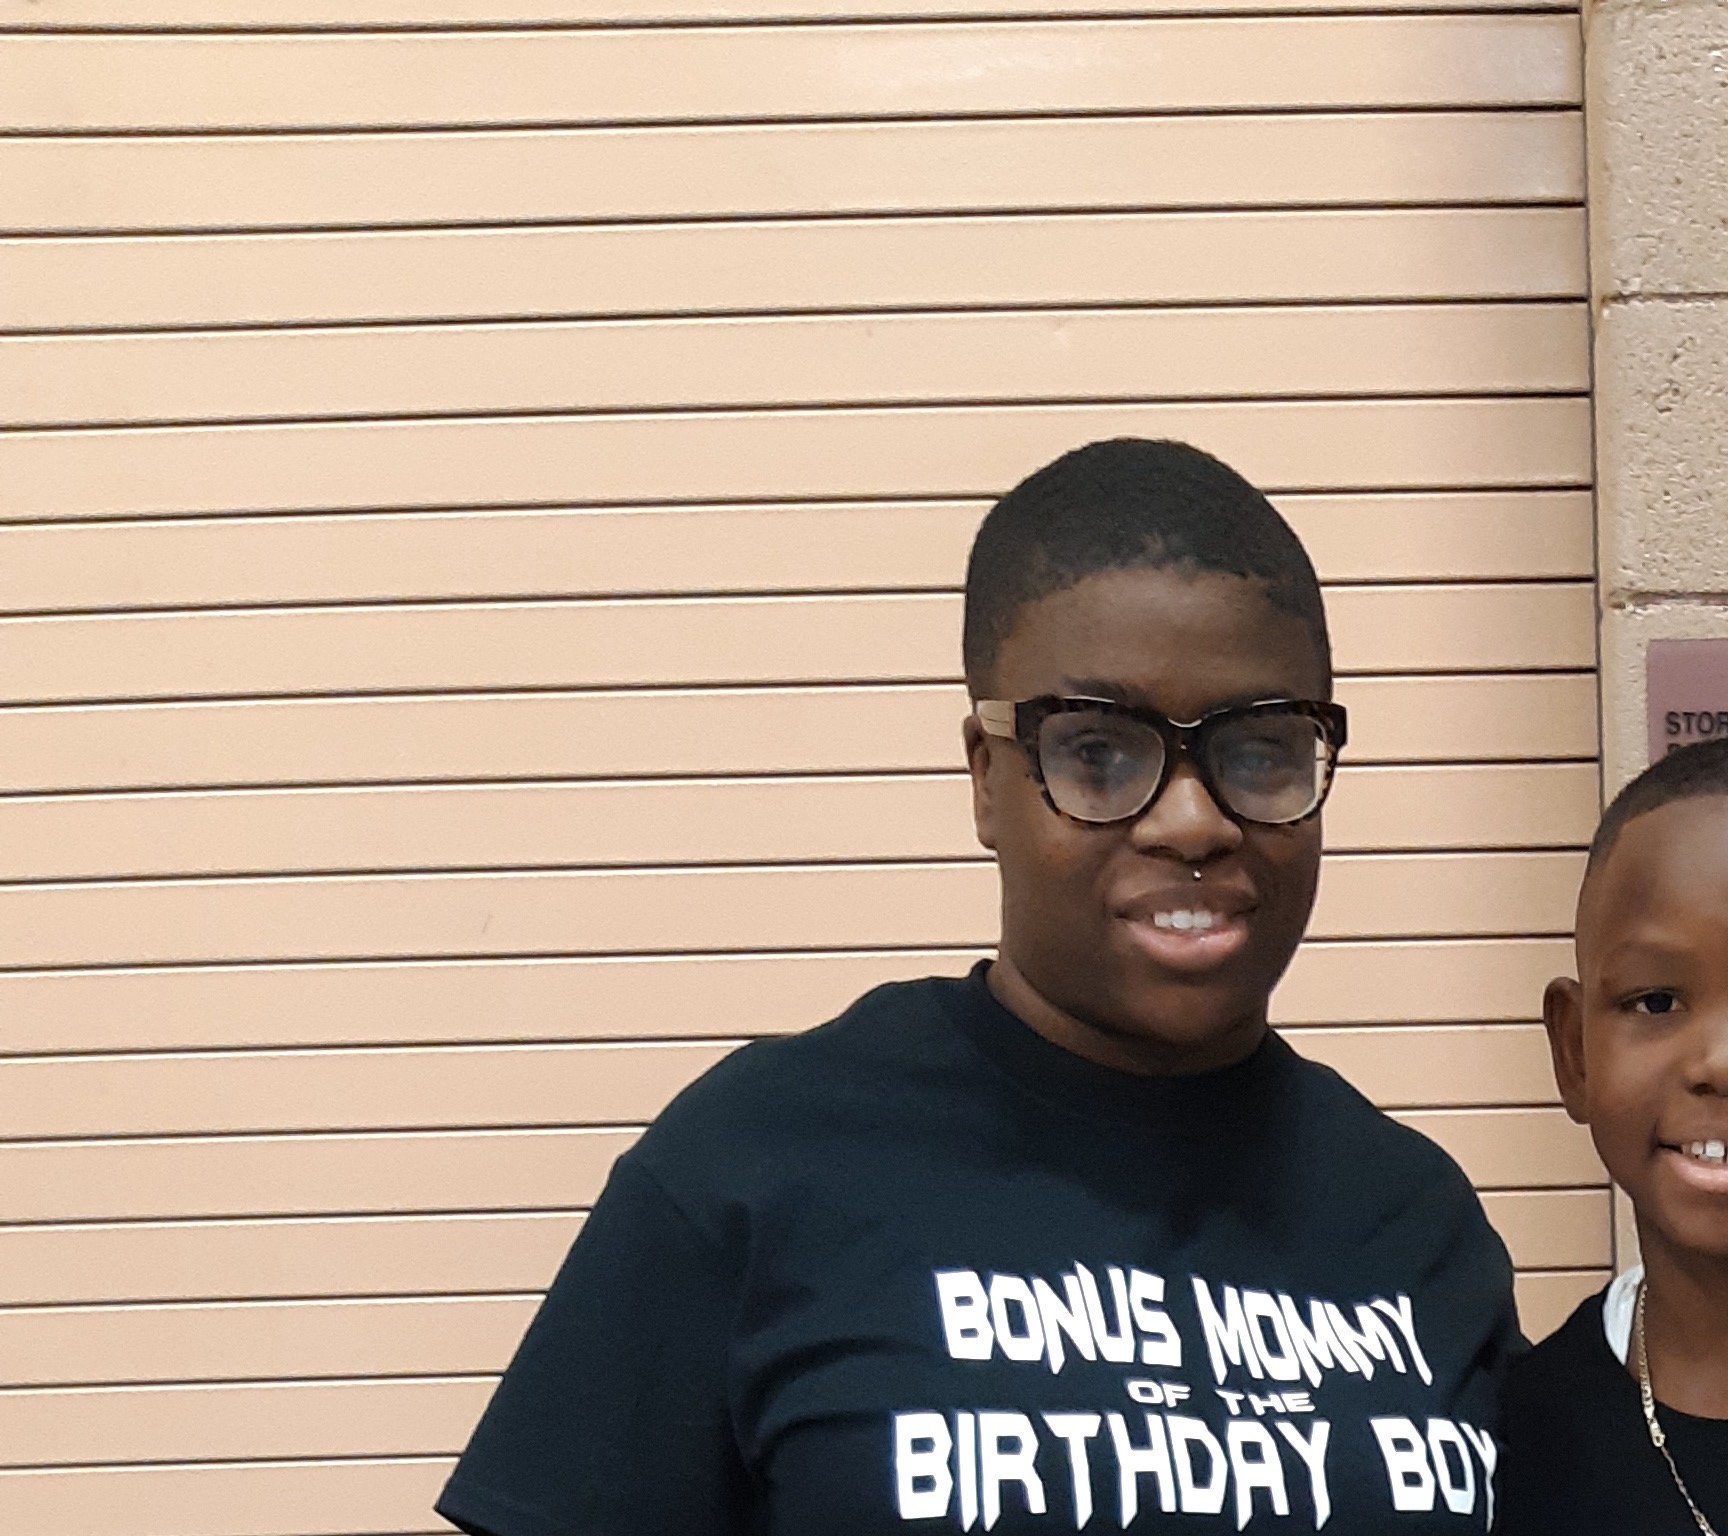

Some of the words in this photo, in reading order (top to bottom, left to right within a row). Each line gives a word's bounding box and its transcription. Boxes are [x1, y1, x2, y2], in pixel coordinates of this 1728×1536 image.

[934, 1260, 1182, 1374] BONUS
[1191, 1276, 1432, 1386] MOMMY
[1126, 1378, 1191, 1408] OF
[1215, 1387, 1317, 1415] THE
[894, 1411, 1330, 1532] BIRTHDAY
[1369, 1416, 1497, 1532] BOY
